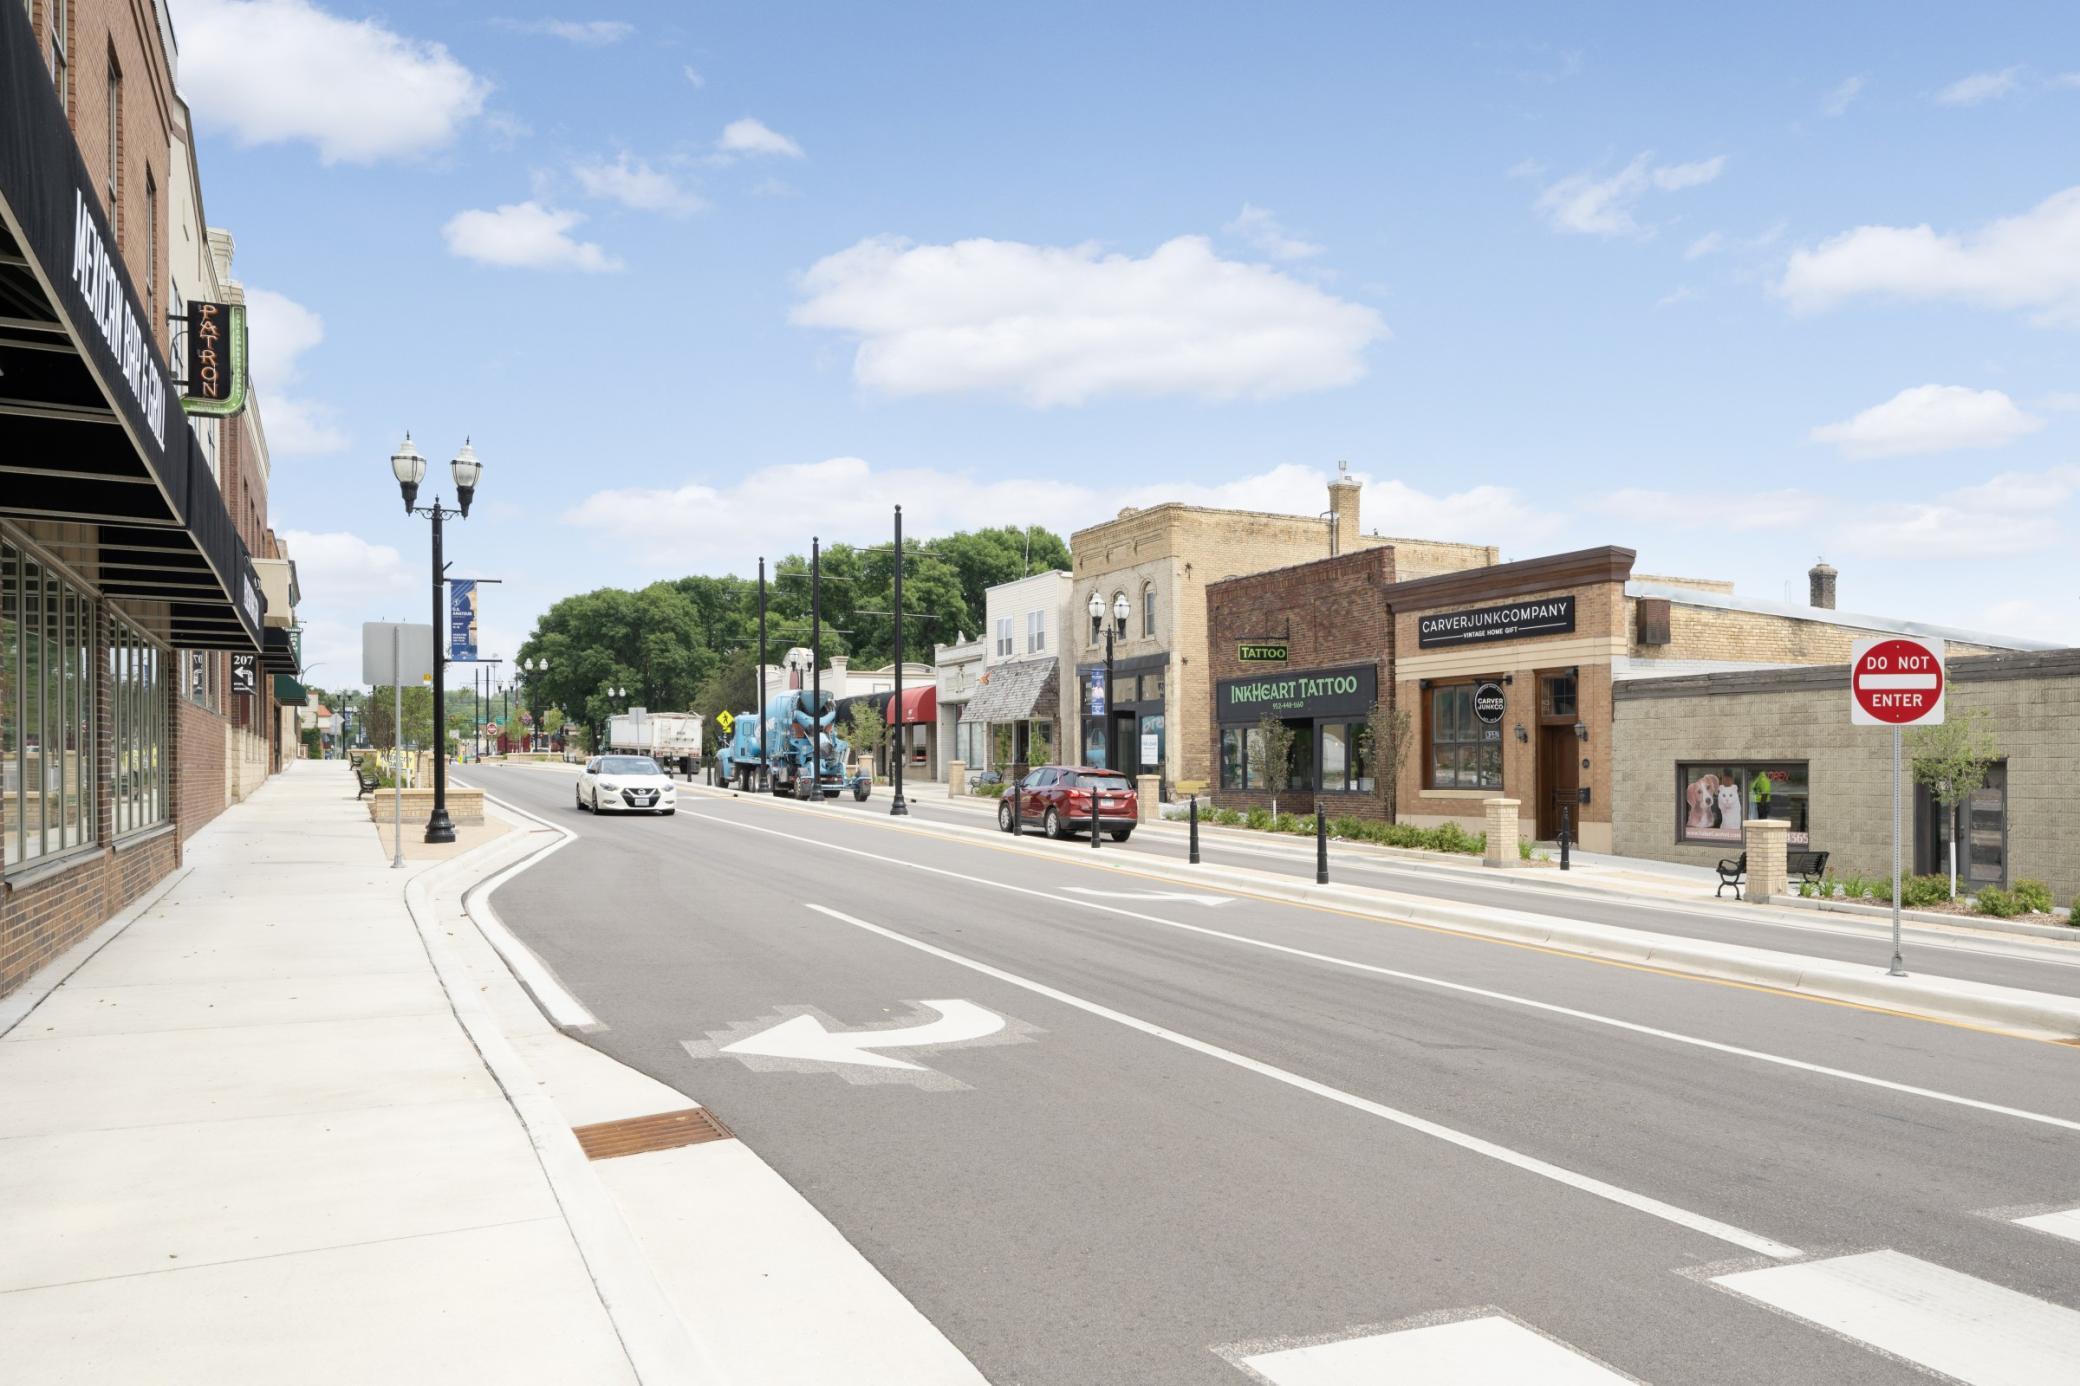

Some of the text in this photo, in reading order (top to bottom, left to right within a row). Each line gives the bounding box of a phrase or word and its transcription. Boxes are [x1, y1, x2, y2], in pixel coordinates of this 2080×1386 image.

[72, 187, 123, 366] MEXICAN
[122, 299, 142, 403] BAR
[147, 357, 166, 452] GRILL
[199, 304, 218, 397] PATRON
[1463, 626, 1518, 639] VINTAGE HOME GIFT
[233, 655, 254, 665] 207
[1241, 647, 1286, 659] TATTOO
[1867, 656, 1930, 670] DO NOT
[1298, 676, 1358, 698] TATTOO
[1872, 693, 1923, 707] ENTER
